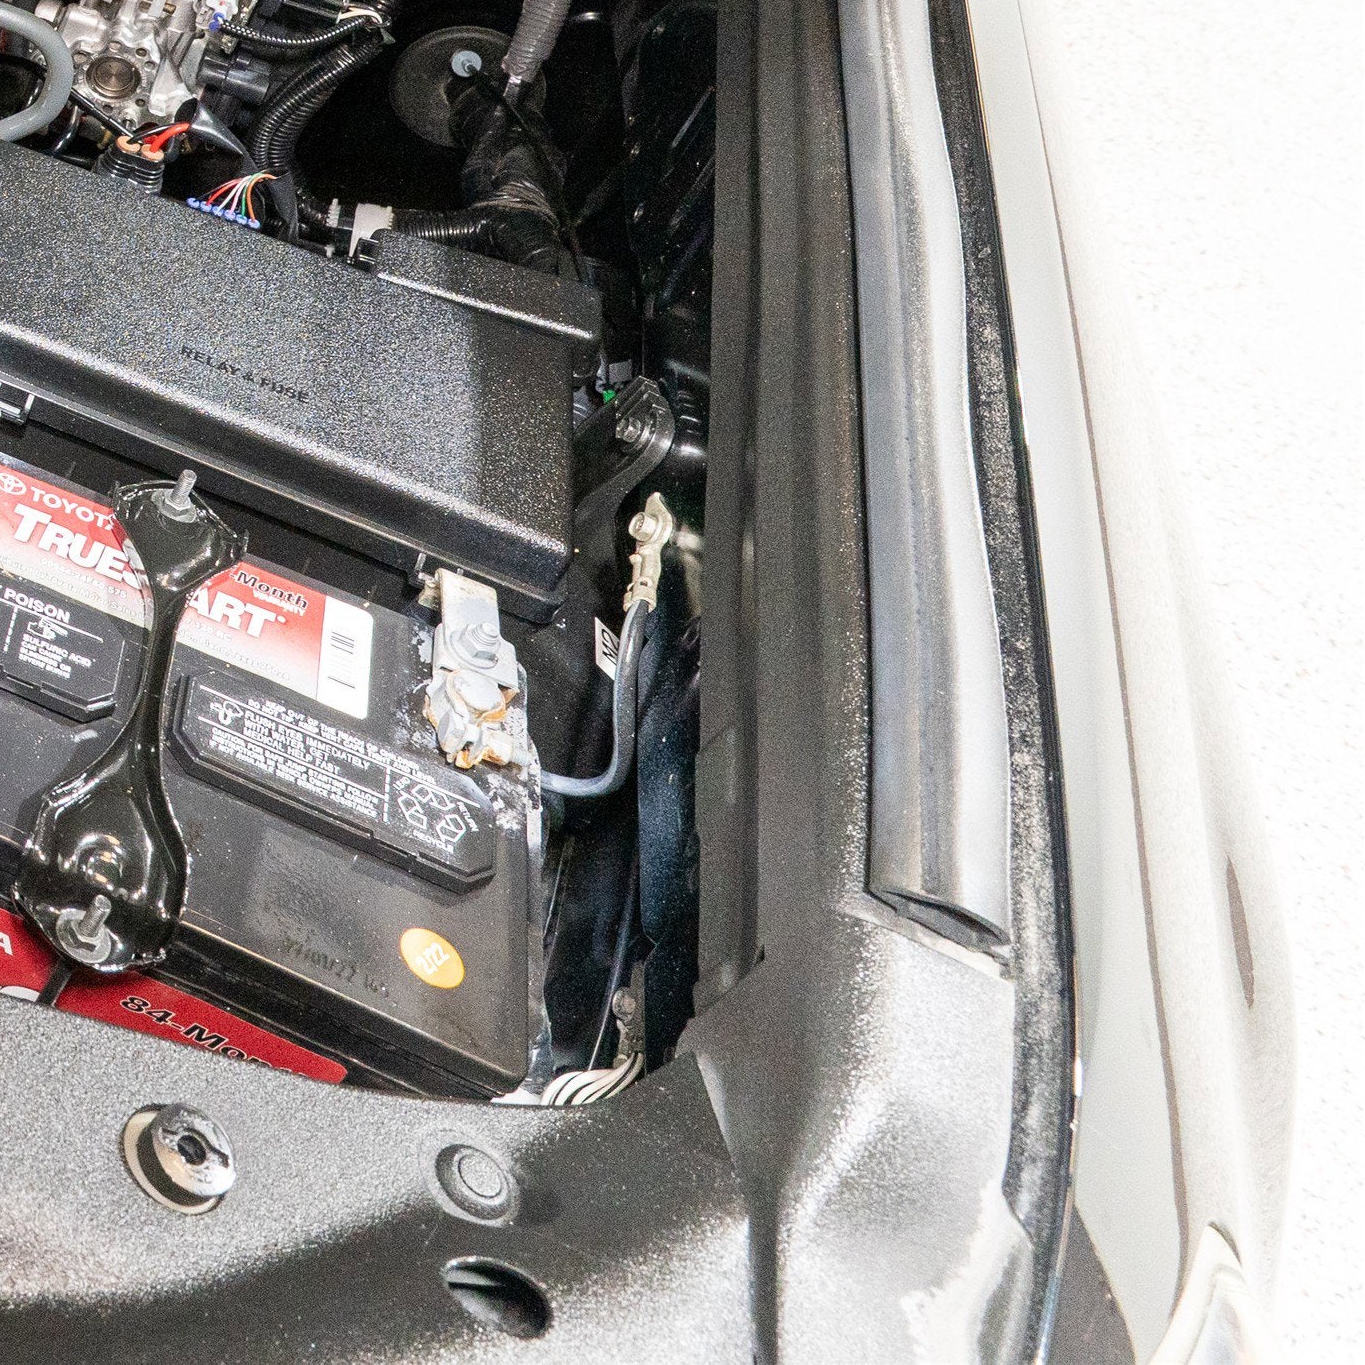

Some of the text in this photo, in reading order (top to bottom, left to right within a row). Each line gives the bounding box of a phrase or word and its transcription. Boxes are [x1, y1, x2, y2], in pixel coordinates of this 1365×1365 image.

[181, 345, 240, 375] RELAY
[260, 377, 310, 404] FUSE
[2, 587, 72, 624] POISON
[21, 633, 92, 668] SULFURIC ACID
[241, 718, 269, 736] WITH
[307, 746, 329, 761] GET
[243, 711, 371, 770] FLUSH EYES IMMEDIATELY
[286, 709, 304, 722] OUT
[319, 723, 336, 735] THE
[336, 731, 364, 747] REACH
[241, 727, 341, 775] MEDICAL HELP FAST
[246, 742, 263, 755] FOR
[263, 750, 284, 764] SAFE
[284, 758, 307, 773] JUMP
[345, 785, 379, 804] FOLLOW
[319, 729, 341, 743] VENT
[342, 739, 365, 754] CAPS
[365, 749, 392, 765] TIGHT
[393, 761, 410, 773] AND
[413, 830, 454, 853] RECYCLE
[120, 995, 306, 1076] 84-Mo
